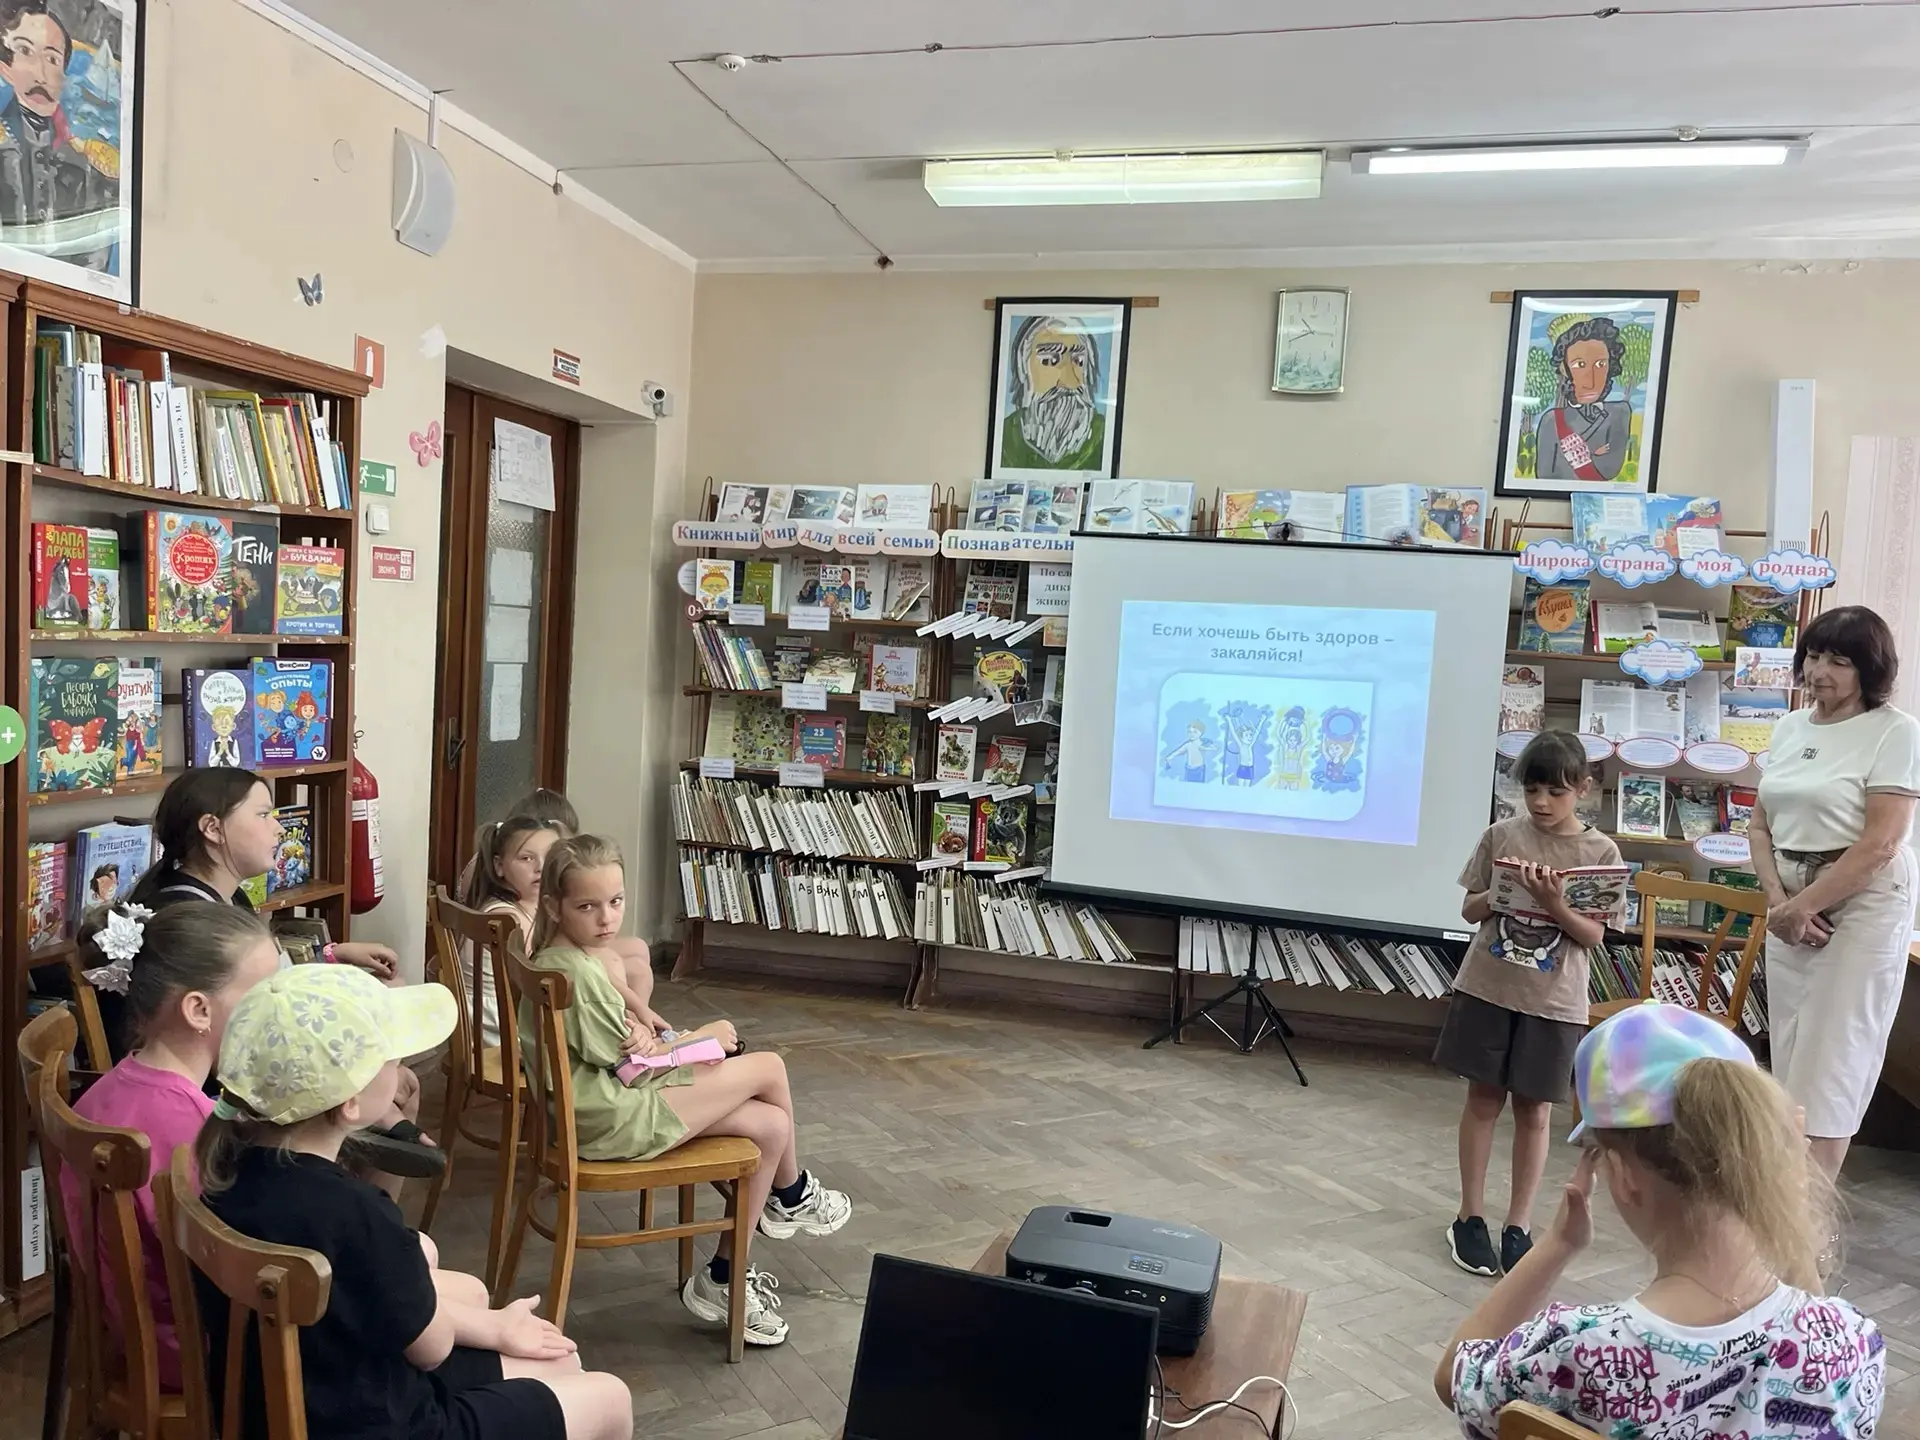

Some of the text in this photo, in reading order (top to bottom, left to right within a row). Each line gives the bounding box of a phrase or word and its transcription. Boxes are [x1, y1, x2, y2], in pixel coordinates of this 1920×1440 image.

[88, 374, 98, 391] Т
[154, 392, 164, 408] У
[315, 427, 325, 441] Ч
[51, 531, 84, 547] ЛАПА
[677, 525, 934, 549] Книжный мир для всей семьи
[46, 545, 86, 559] ДРУЖБЫ
[232, 536, 273, 565] ТЕНИ
[290, 553, 332, 564] БУКВАМИ
[1517, 553, 1592, 569] Широка
[1602, 557, 1666, 573] страна
[1696, 558, 1732, 573] моя
[1758, 560, 1828, 578] родная
[1040, 568, 1055, 577] По
[972, 583, 1014, 592] ЖИВОТНОГО
[993, 592, 1014, 601] МИРА
[1036, 598, 1070, 607] живо
[1152, 623, 1192, 637] Если
[1199, 626, 1260, 640] хочешь
[1265, 627, 1309, 643] быть
[1315, 633, 1378, 648] здоров
[1210, 646, 1303, 663] закаляйся!
[271, 679, 313, 689] ОПЫТЫ
[61, 692, 97, 708] БАБОЧКА
[813, 728, 825, 737] 25
[798, 882, 806, 892] А
[816, 882, 823, 894] В
[831, 888, 839, 898] К
[857, 888, 868, 898] М
[876, 889, 886, 900] Н
[918, 890, 925, 900] П
[944, 896, 950, 906] Т
[981, 902, 989, 912] У
[1020, 902, 1029, 912] Б
[1042, 905, 1049, 914] В
[1055, 907, 1062, 917] Г
[1082, 911, 1091, 922] Д
[1310, 937, 1320, 947] О
[1350, 942, 1361, 953] П
[1406, 945, 1416, 956] С
[1674, 977, 1697, 1009] ЕРРО
[30, 1175, 41, 1258] Линдгрен Астрид
